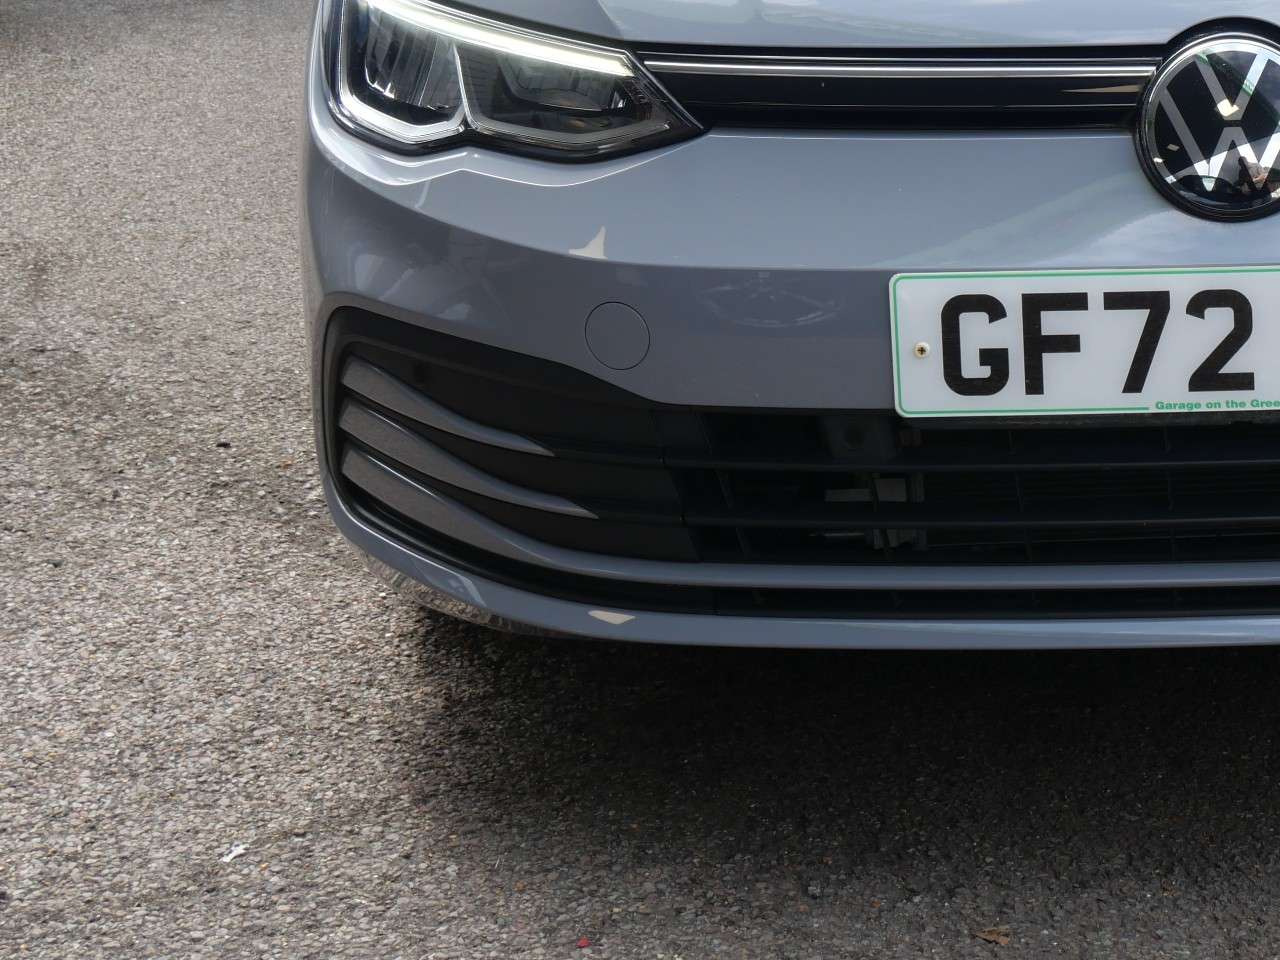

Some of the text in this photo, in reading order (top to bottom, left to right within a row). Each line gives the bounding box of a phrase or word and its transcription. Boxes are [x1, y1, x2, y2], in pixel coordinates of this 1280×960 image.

[940, 288, 1256, 397] GF72
[1155, 400, 1202, 411] Garage
[1206, 400, 1221, 409] on
[1225, 399, 1246, 409] the
